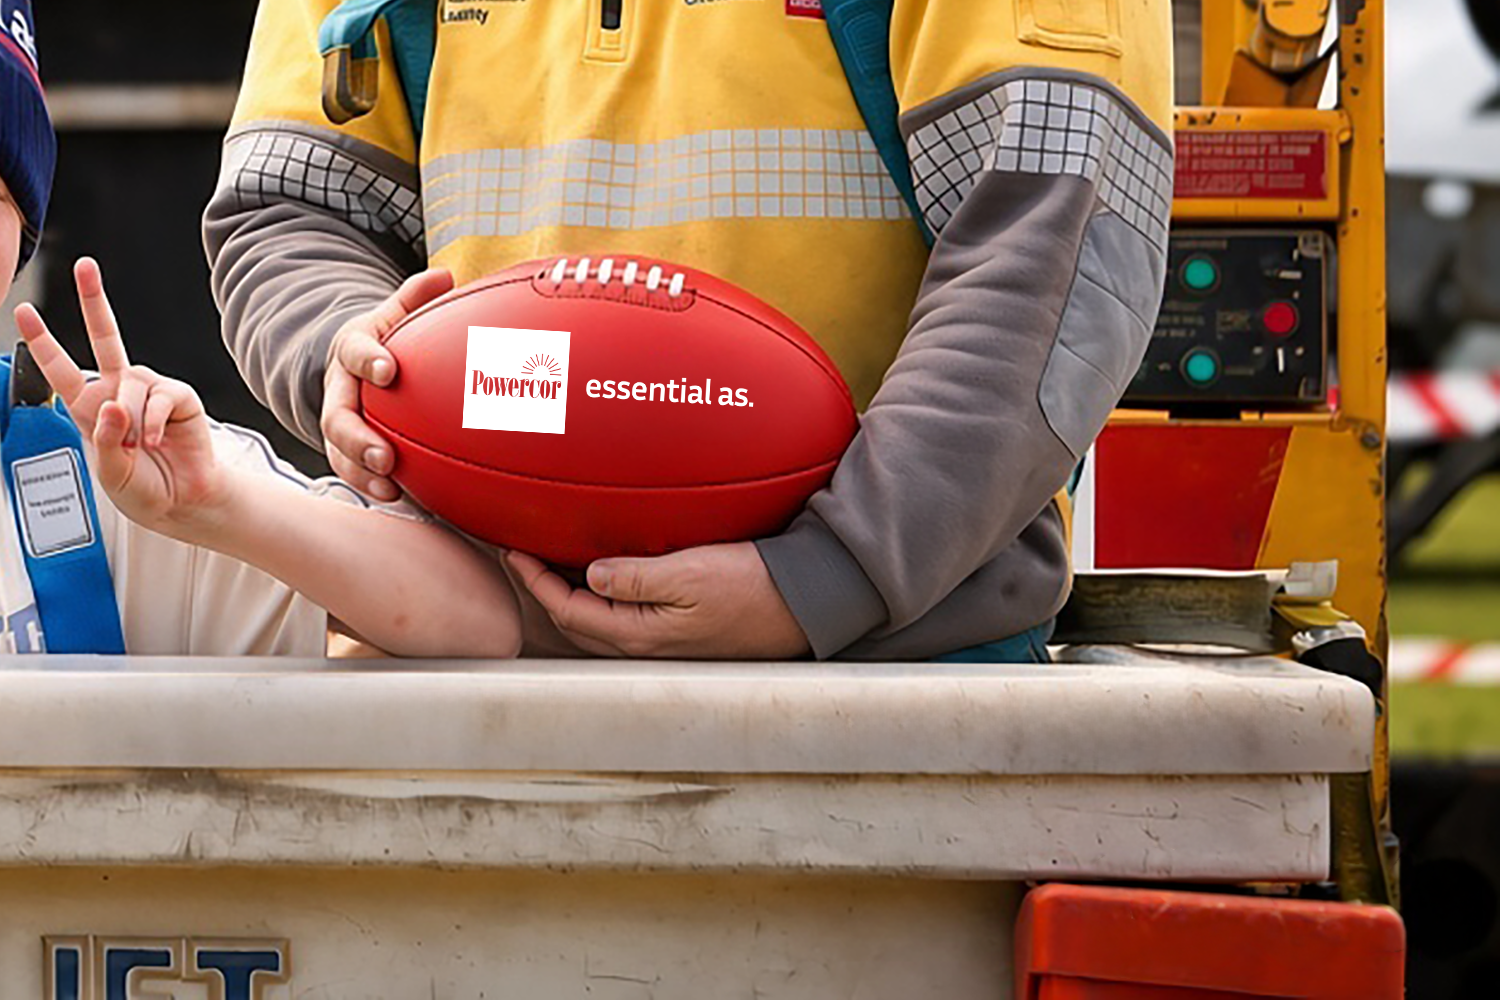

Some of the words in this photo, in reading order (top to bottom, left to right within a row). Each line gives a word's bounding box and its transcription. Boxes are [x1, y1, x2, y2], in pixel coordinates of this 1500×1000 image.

[471, 369, 562, 400] Powercor
[585, 377, 712, 405] essential
[718, 386, 754, 408] as.
